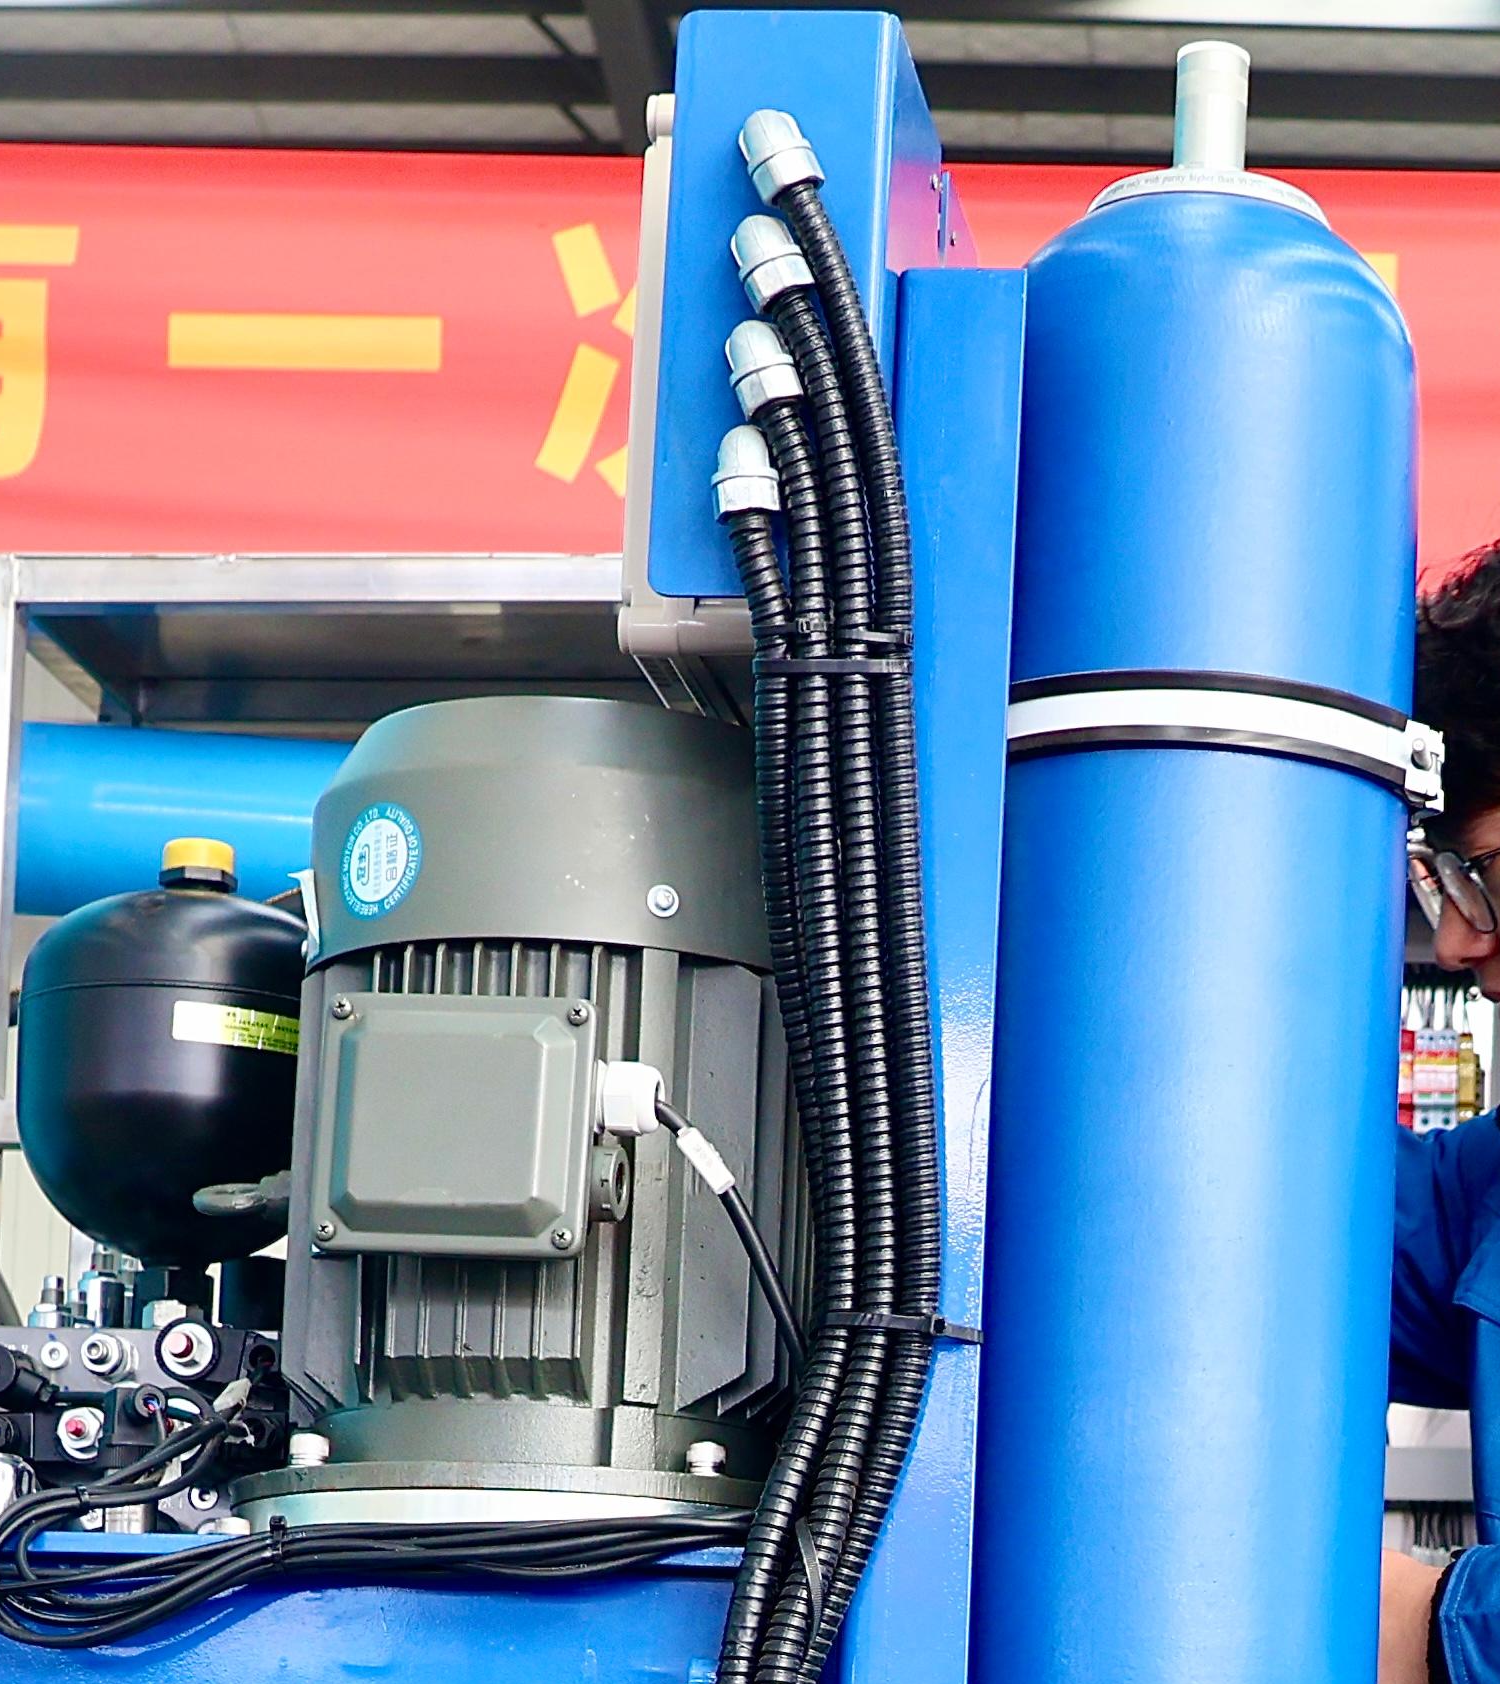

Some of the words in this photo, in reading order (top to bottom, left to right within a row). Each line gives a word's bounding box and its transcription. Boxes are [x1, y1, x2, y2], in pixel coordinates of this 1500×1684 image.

[384, 806, 415, 835] QUALITY
[407, 835, 419, 849] OF
[383, 848, 419, 910] CERTIFICATE
